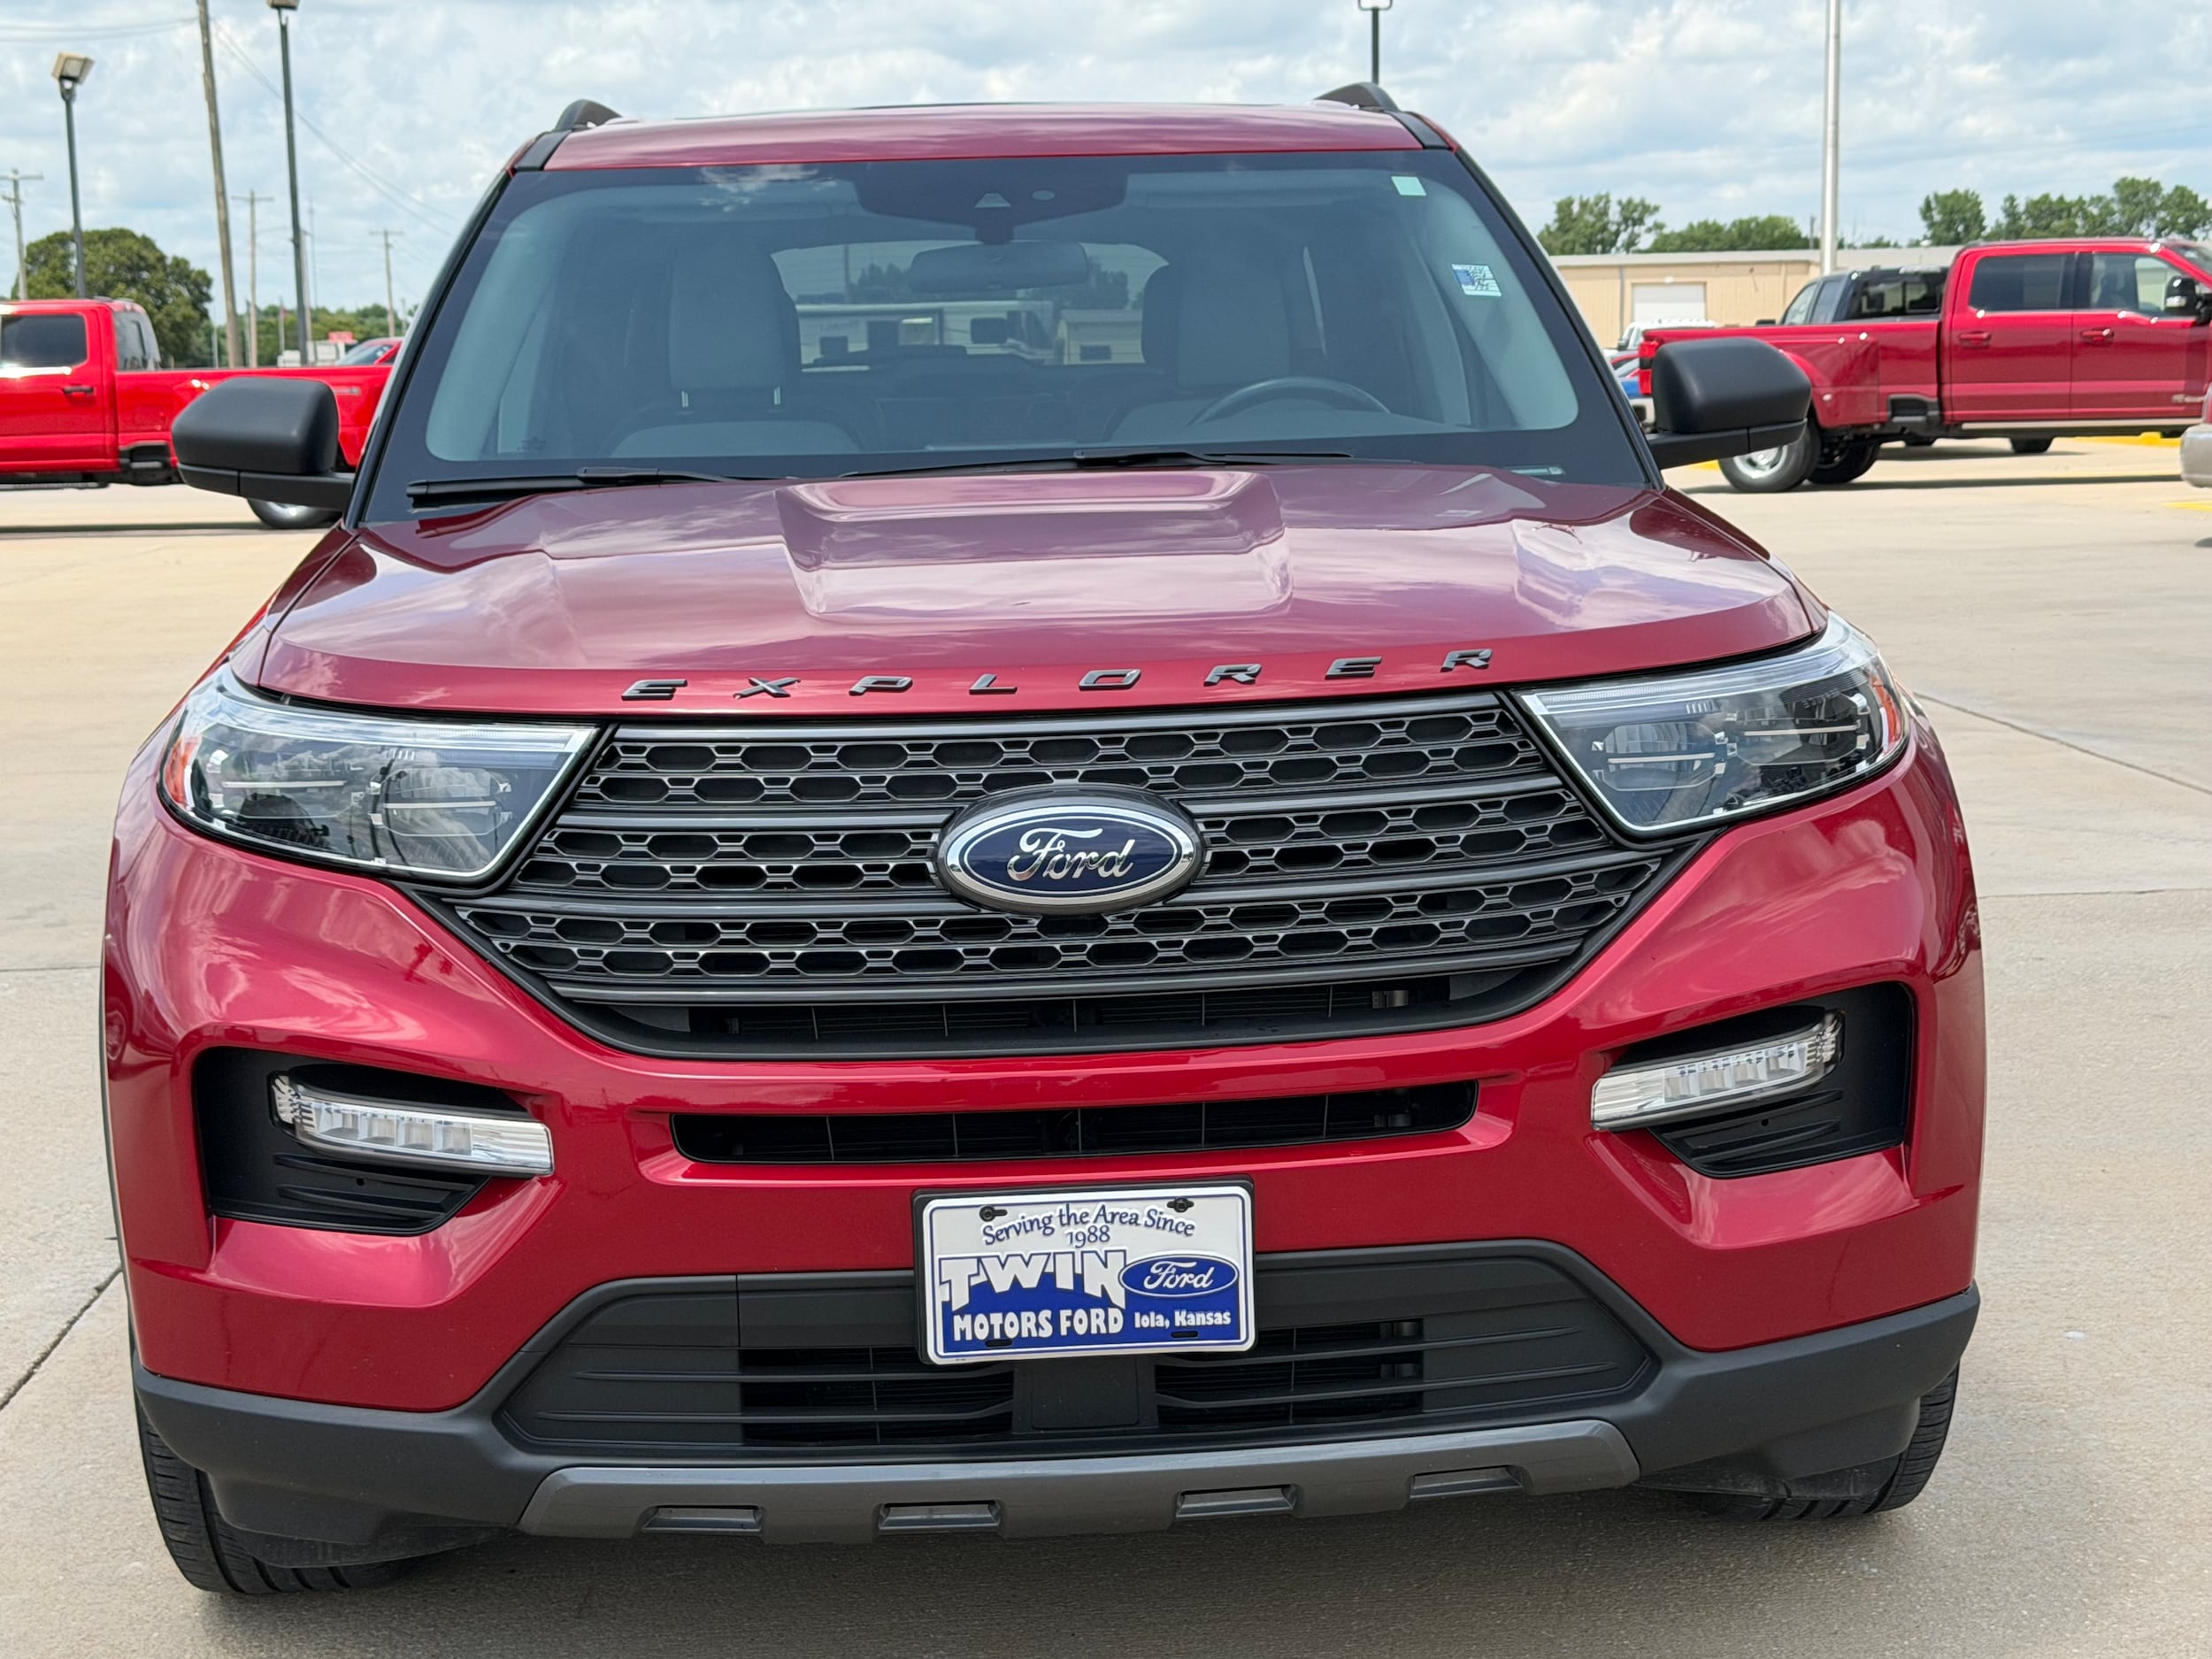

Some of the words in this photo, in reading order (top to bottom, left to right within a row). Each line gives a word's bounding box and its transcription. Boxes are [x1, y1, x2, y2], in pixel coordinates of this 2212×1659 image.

[621, 648, 1493, 701] EXPLORER
[1006, 827, 1136, 882] Ford
[983, 1214, 1054, 1245] Serving
[1056, 1203, 1089, 1226] the
[1093, 1204, 1140, 1226] Area
[1143, 1209, 1195, 1236] Since
[1068, 1225, 1110, 1248] 1988
[940, 1250, 1126, 1312] TWIN
[1143, 1261, 1214, 1289] Ford
[953, 1310, 1053, 1341] MOTORS
[1060, 1308, 1124, 1338] FORD
[1134, 1312, 1171, 1329] Iola,
[1174, 1310, 1232, 1327] Kansas
